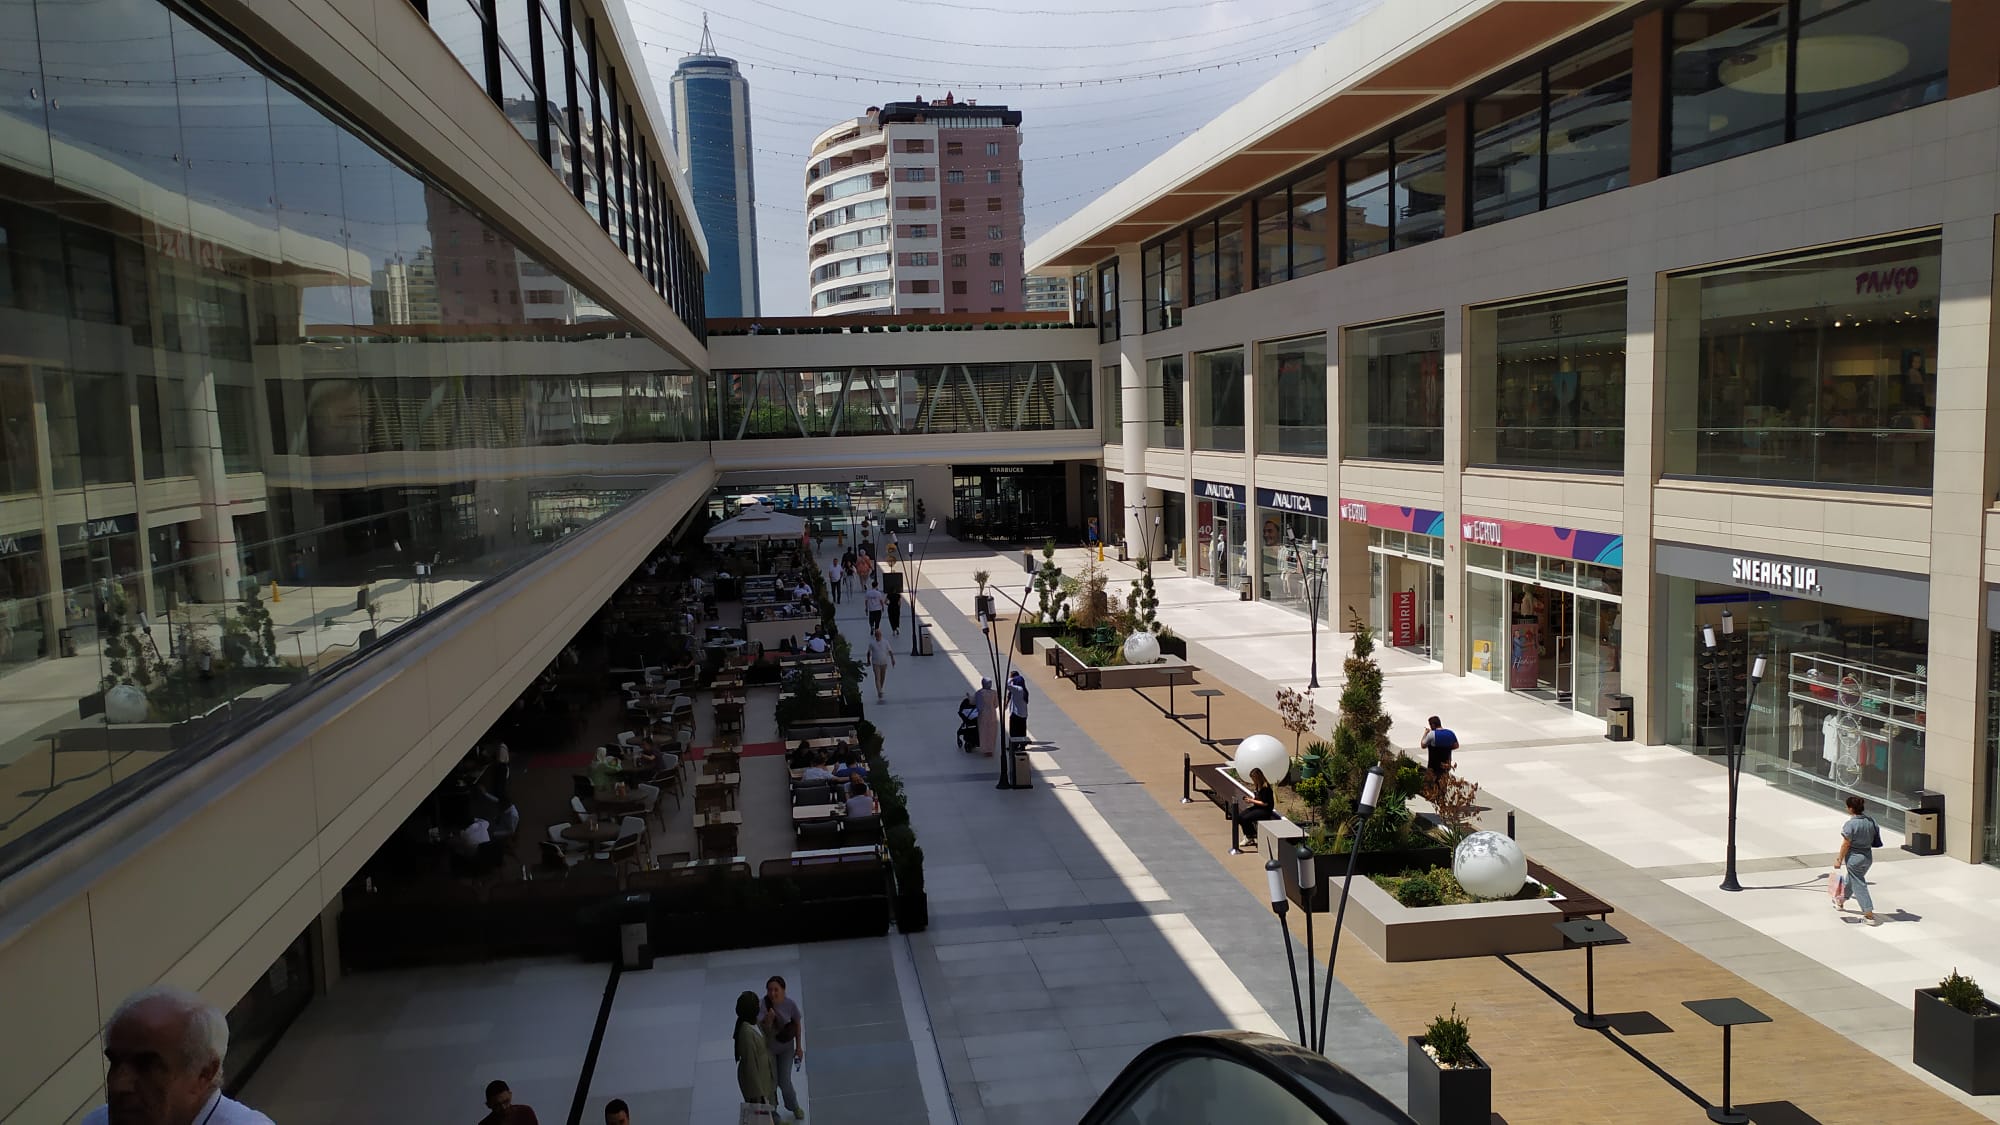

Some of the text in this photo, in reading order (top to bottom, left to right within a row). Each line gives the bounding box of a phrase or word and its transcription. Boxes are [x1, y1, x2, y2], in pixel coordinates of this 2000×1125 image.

[1855, 266, 1919, 295] PANÇO
[1204, 483, 1235, 500] NAUTICA
[1272, 492, 1312, 512] NAUTICA
[1732, 557, 1792, 587] SNEAKS
